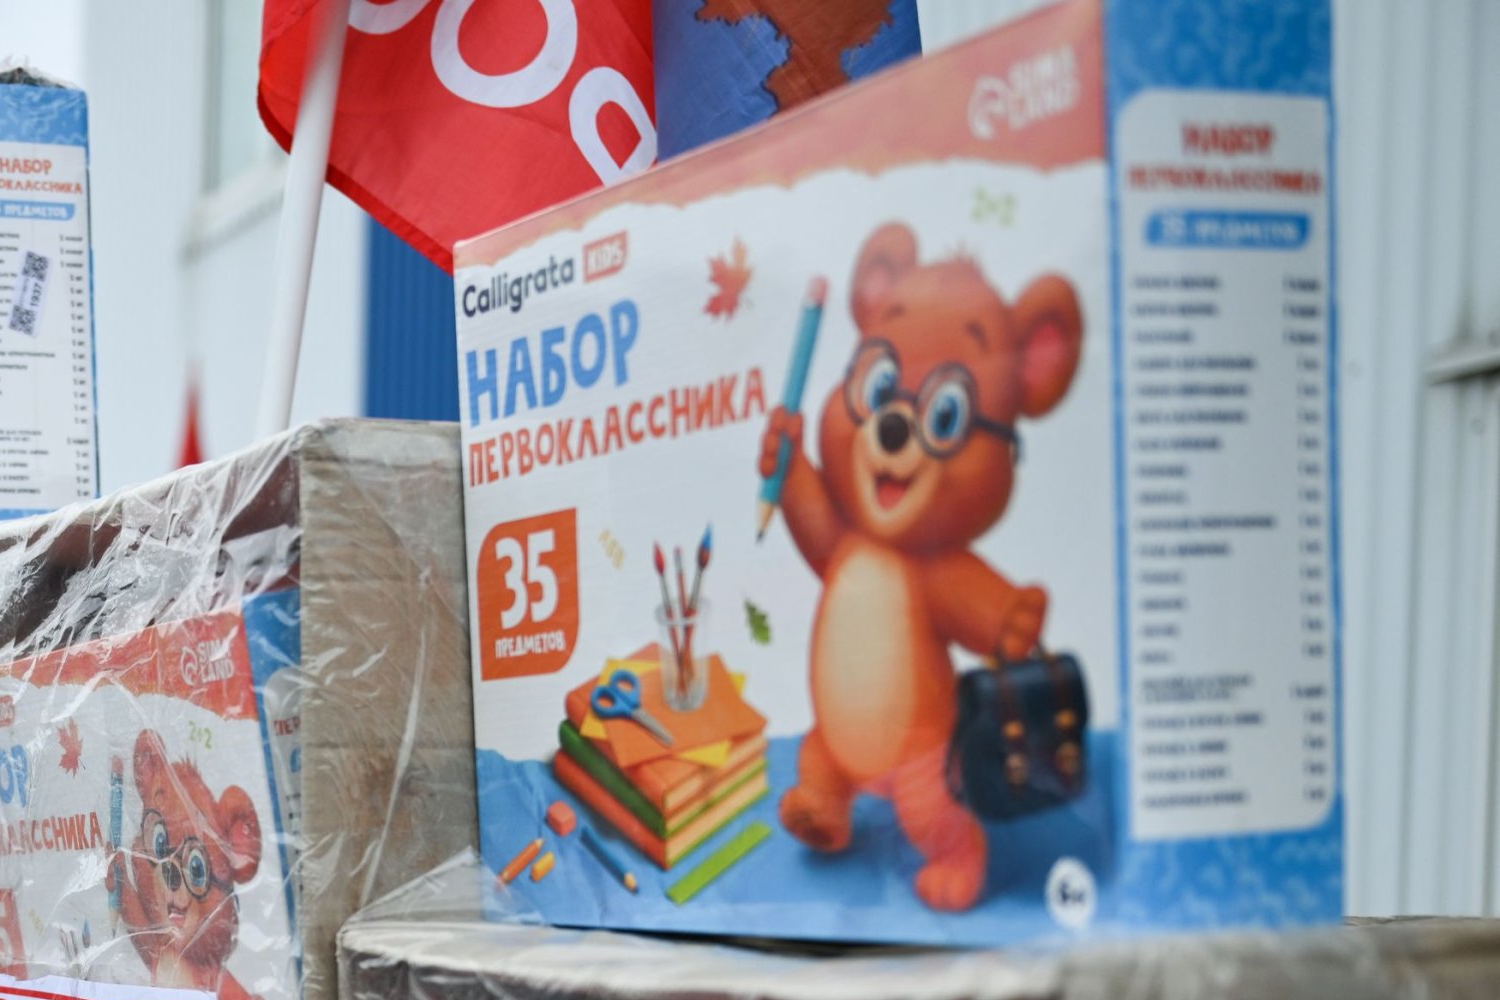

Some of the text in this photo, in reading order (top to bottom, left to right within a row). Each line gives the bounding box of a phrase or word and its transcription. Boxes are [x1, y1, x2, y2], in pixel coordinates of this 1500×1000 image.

[462, 254, 575, 319] Calligrata
[465, 298, 639, 428] НАБОР
[469, 366, 766, 488] ПЕРВОКЛАССНИКА
[495, 529, 559, 630] 35
[495, 630, 566, 660] ПРЕДМЕТОВ
